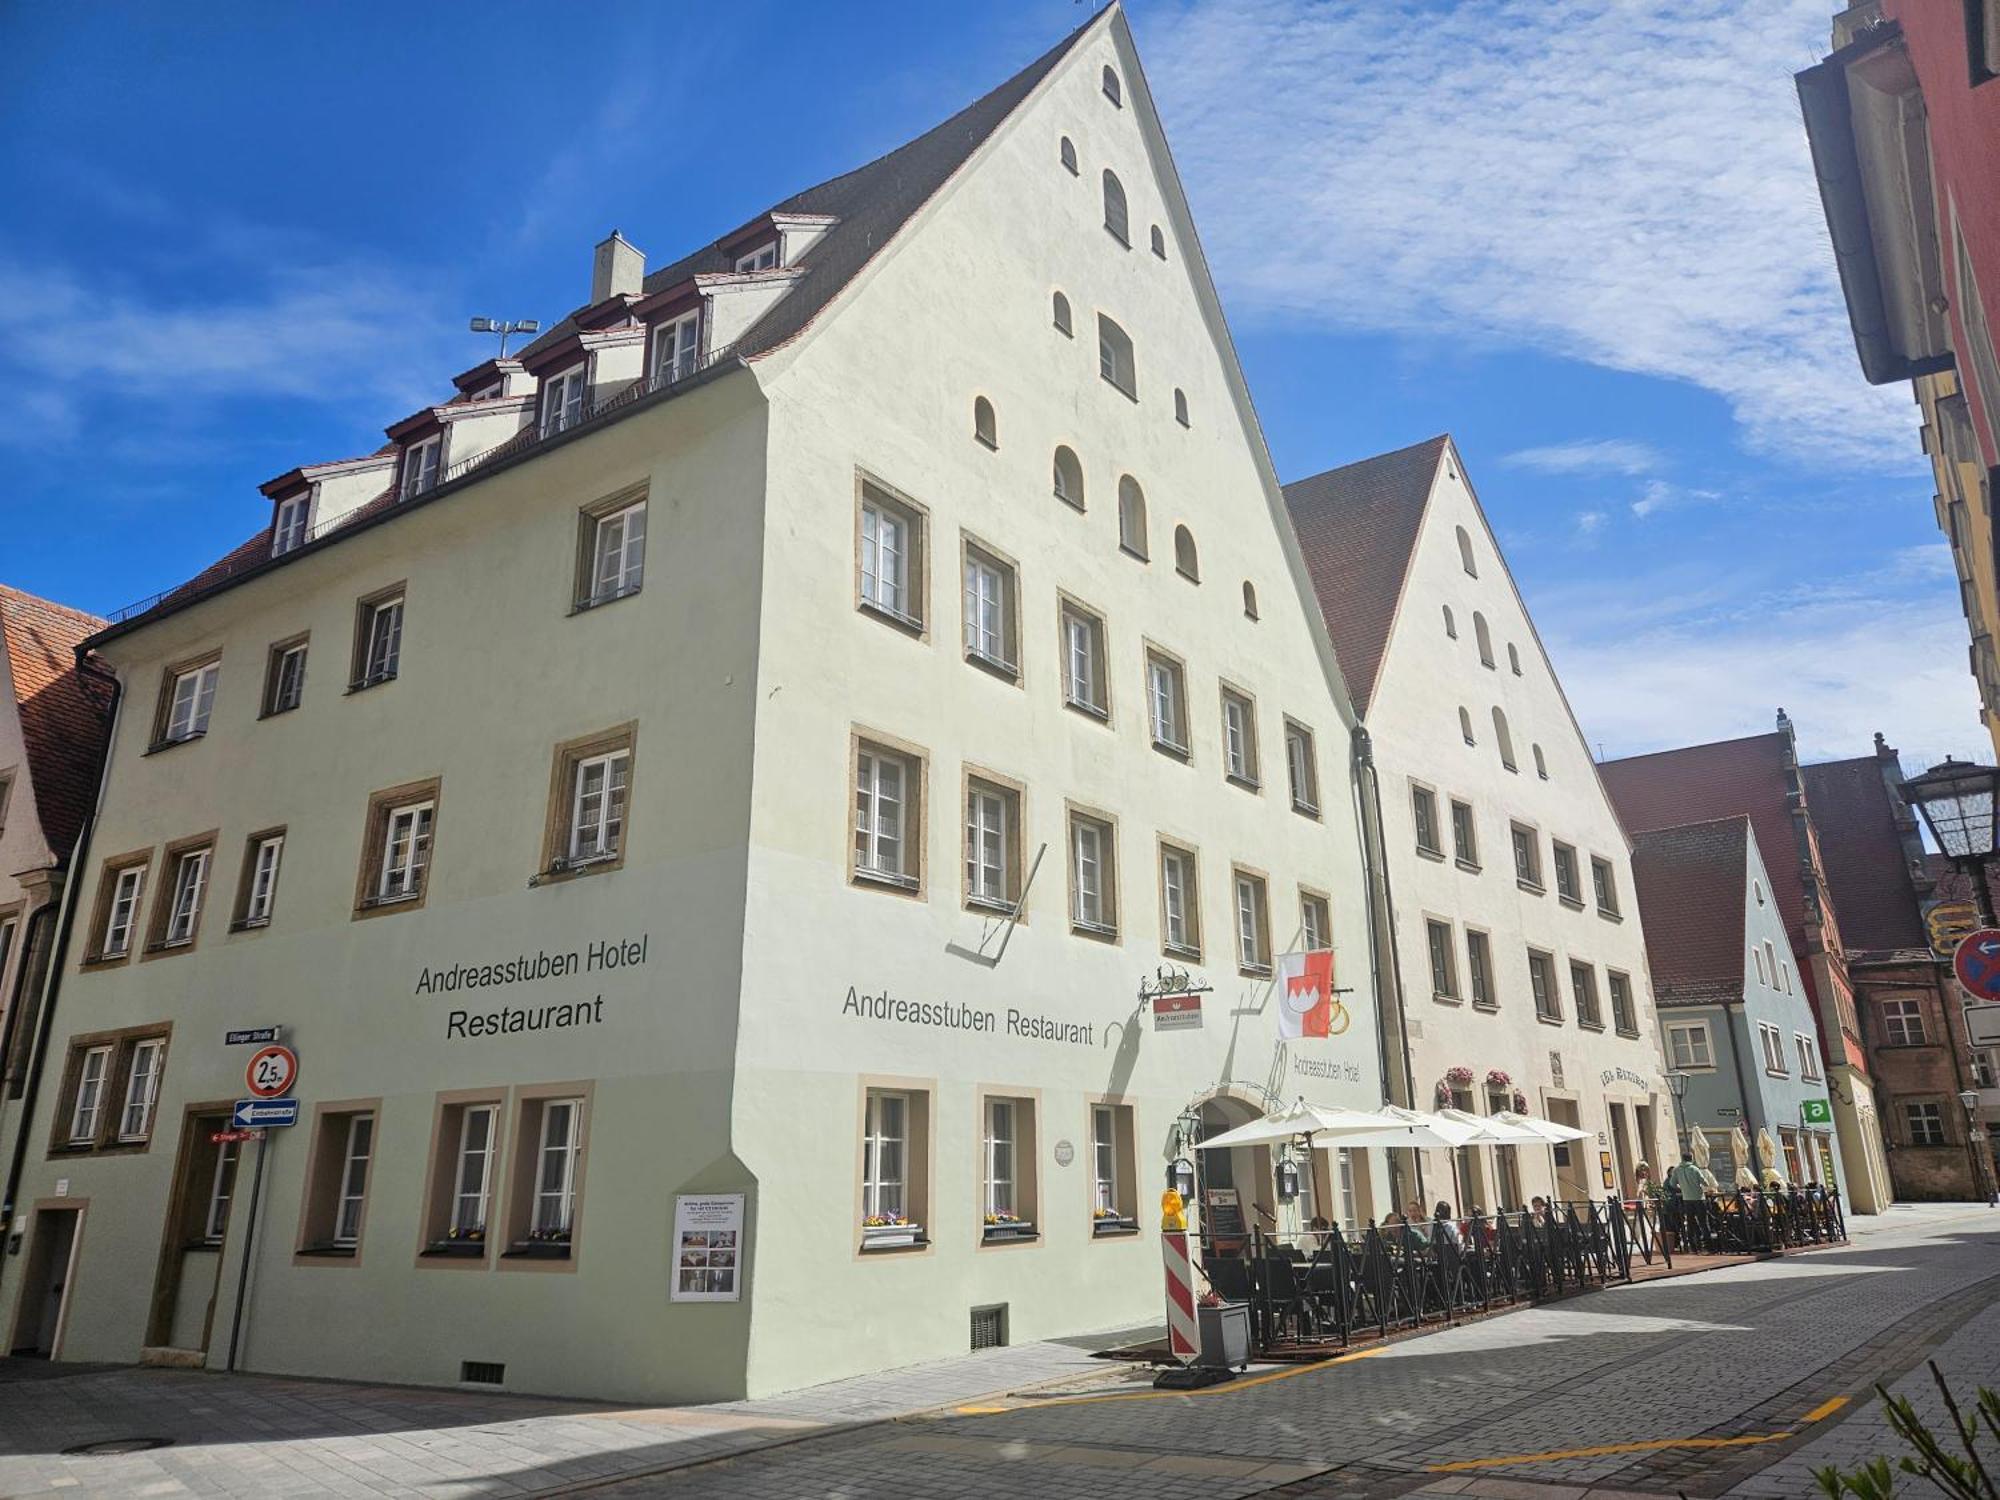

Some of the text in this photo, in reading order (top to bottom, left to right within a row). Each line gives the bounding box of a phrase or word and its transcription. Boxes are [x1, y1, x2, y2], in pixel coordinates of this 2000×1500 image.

[415, 934, 648, 995] Andreasstuben Hotel
[447, 995, 604, 1040] Restaurant
[842, 986, 1094, 1046] Andreasstuben Restaurant
[1811, 1103, 1824, 1117] a
